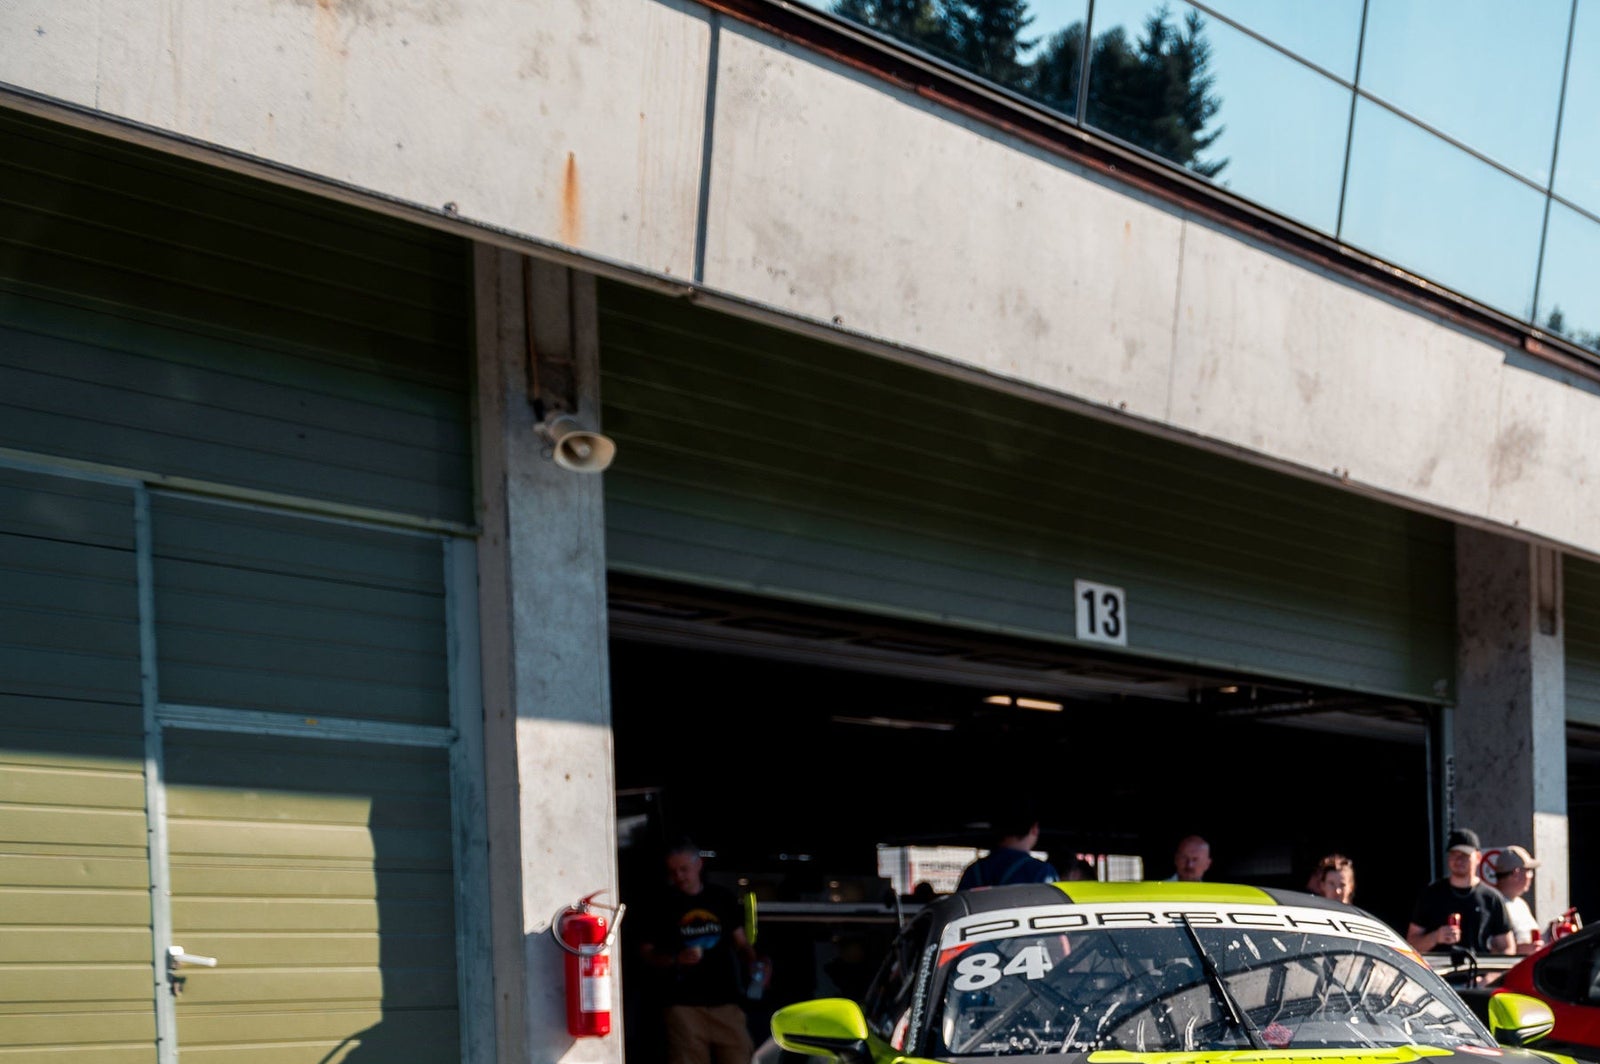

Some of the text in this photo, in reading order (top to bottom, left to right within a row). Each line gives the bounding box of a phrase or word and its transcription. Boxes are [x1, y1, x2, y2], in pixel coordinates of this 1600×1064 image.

[1083, 589, 1121, 638] 13
[959, 911, 1396, 943] PORSCHE
[952, 946, 1050, 992] 84
